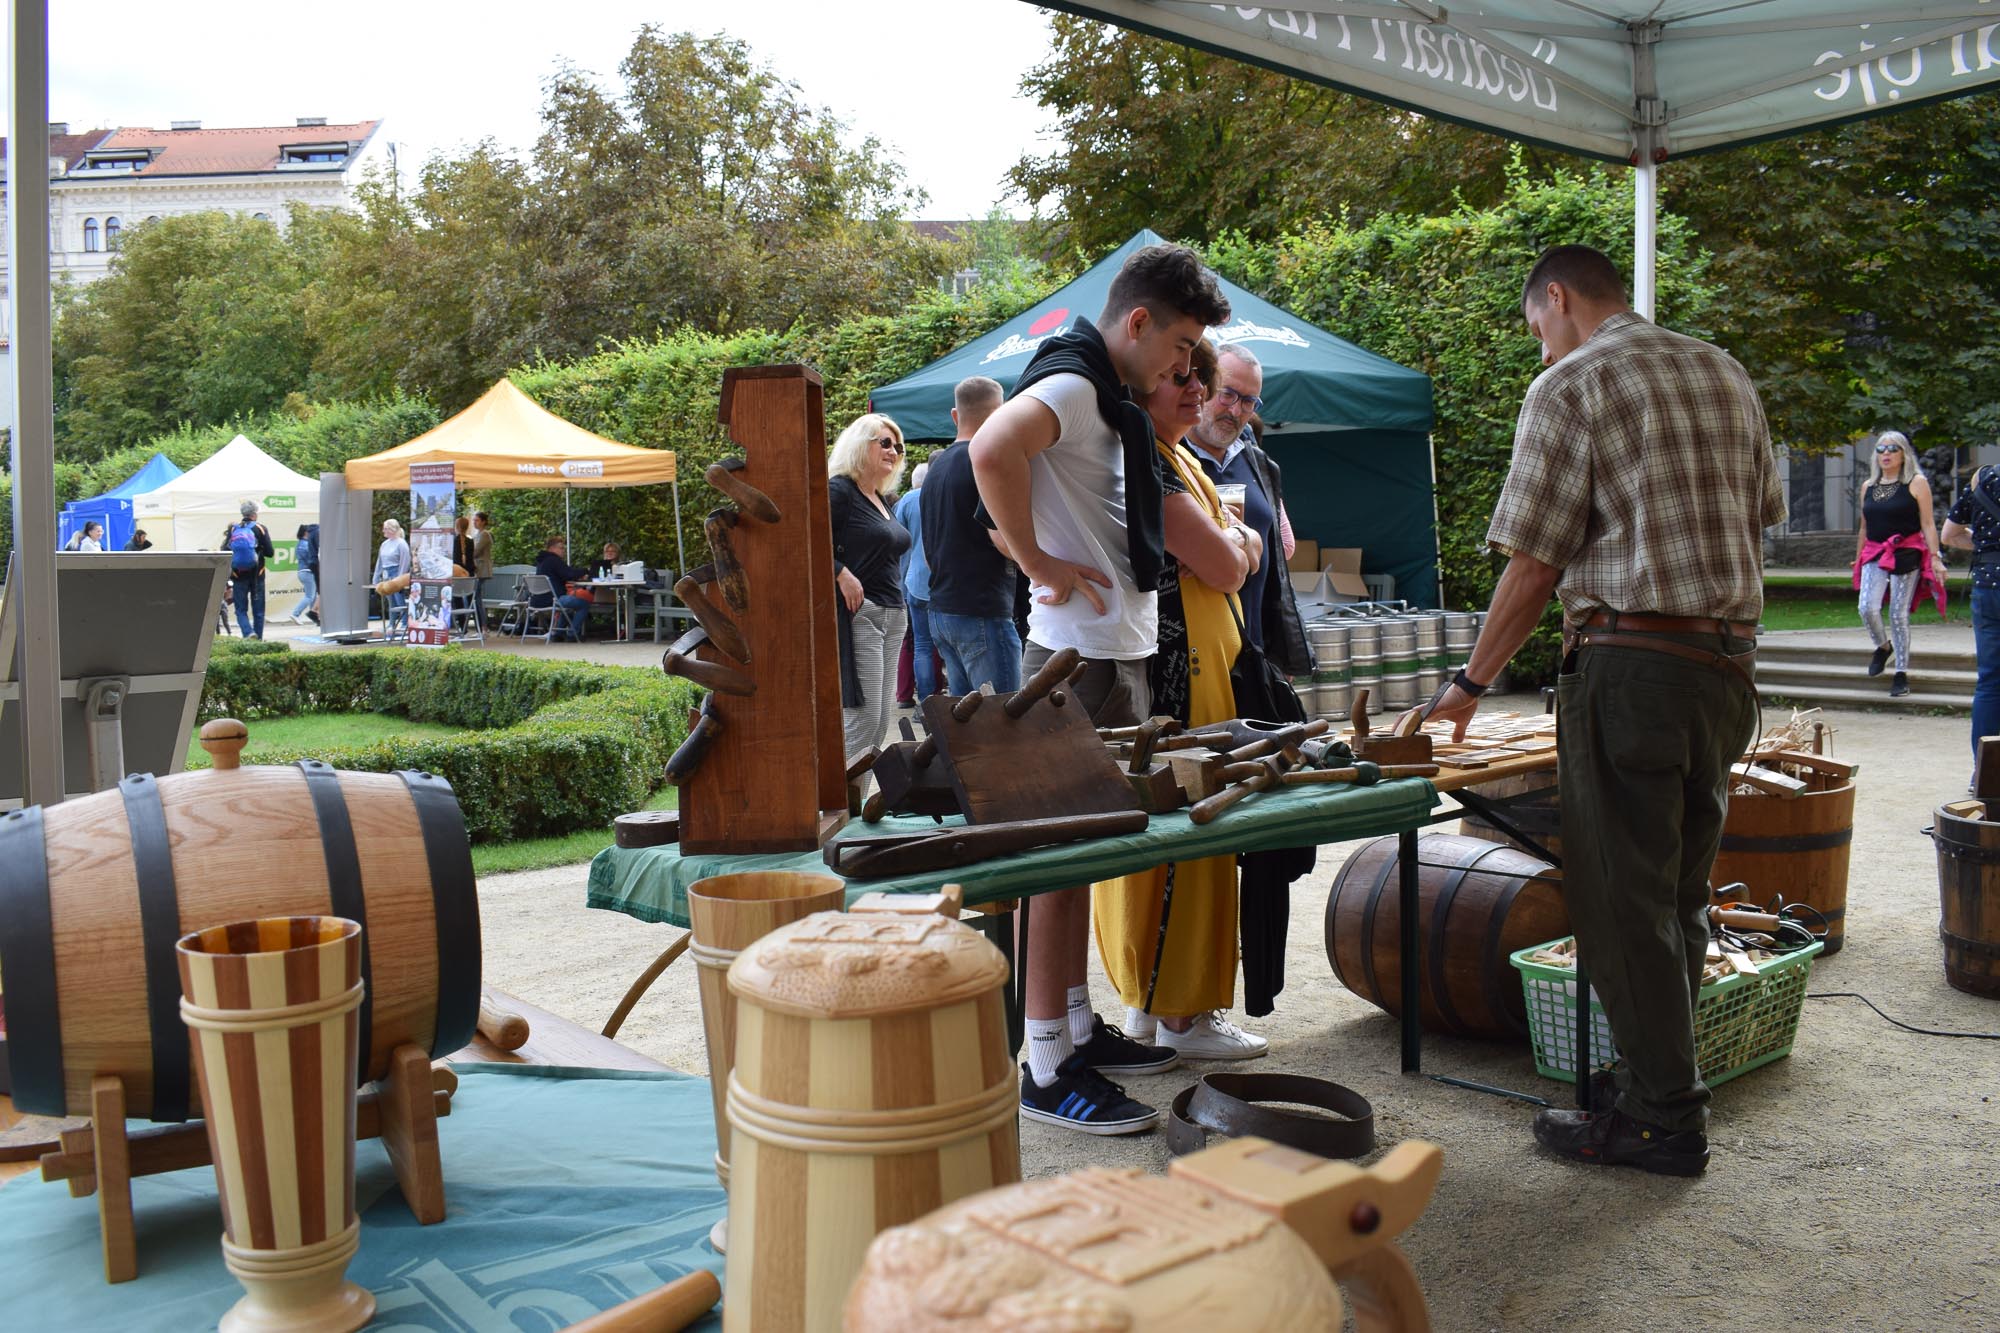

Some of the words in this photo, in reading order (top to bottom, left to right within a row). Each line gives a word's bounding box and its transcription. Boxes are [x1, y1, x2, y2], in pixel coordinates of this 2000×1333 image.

[517, 463, 555, 474] Město
[568, 464, 599, 475] Plzeň
[269, 497, 294, 507] Plzeň
[273, 547, 299, 565] Pl
